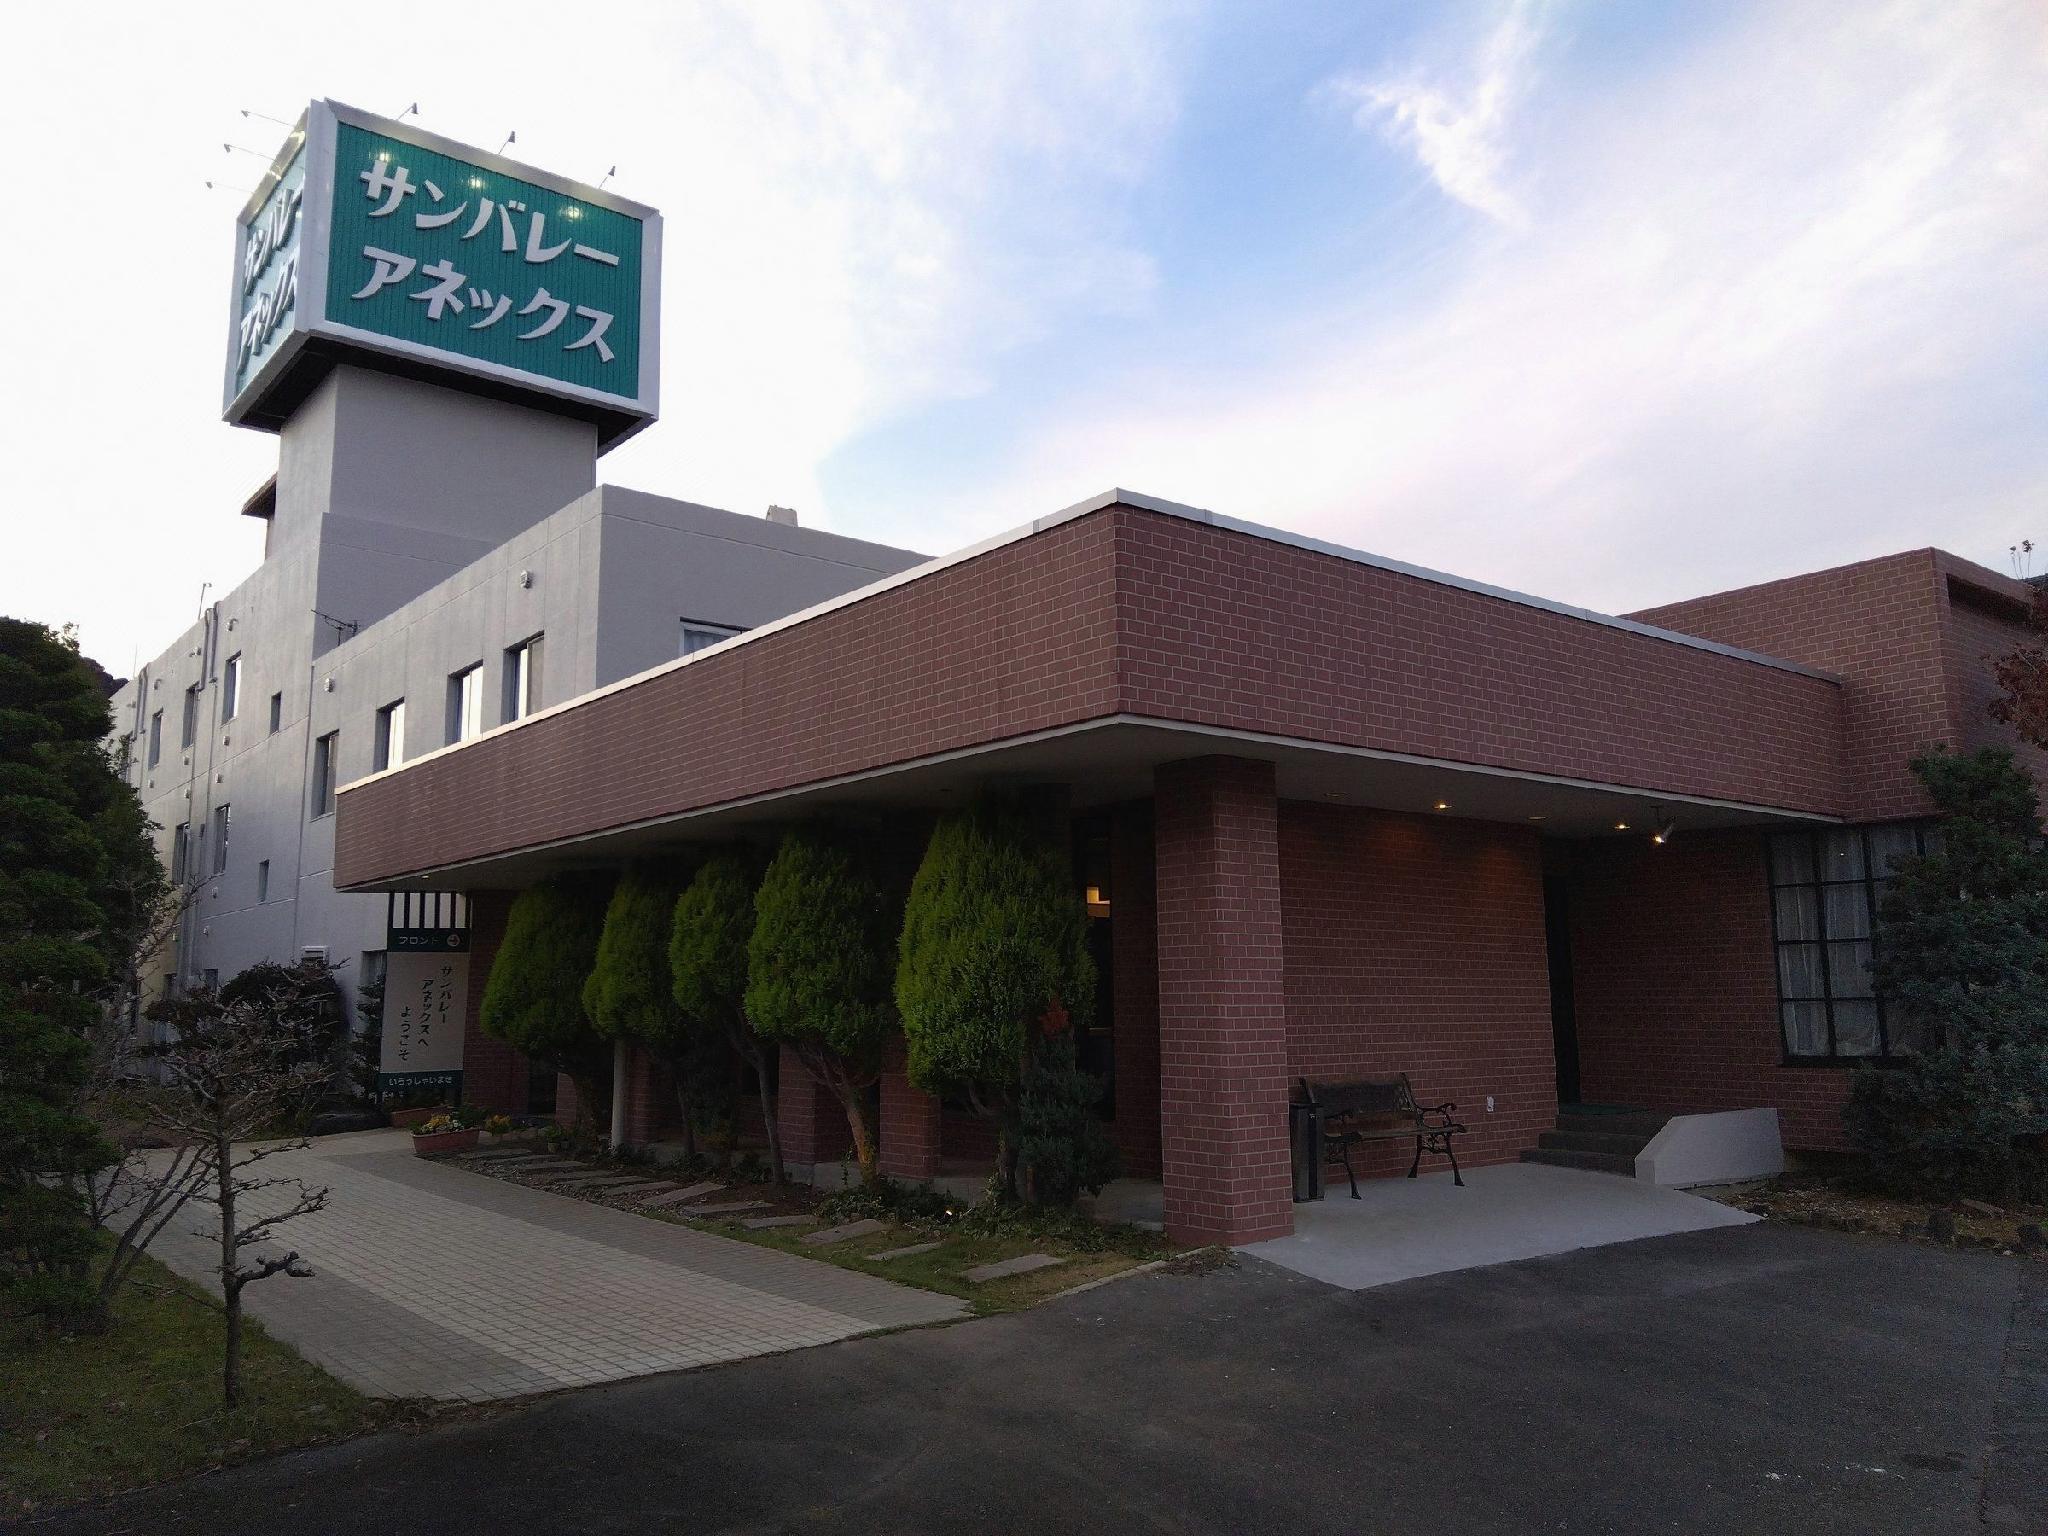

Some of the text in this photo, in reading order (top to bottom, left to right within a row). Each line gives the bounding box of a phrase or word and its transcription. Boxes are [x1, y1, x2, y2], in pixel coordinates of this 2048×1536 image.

[360, 159, 620, 266] サンバレー
[351, 246, 615, 362] アネックス
[418, 979, 434, 1046] アネックスへ
[438, 966, 452, 1023] サンバレー
[398, 1006, 411, 1061] ようこそ
[388, 1076, 452, 1086] いらっしゃいませ
